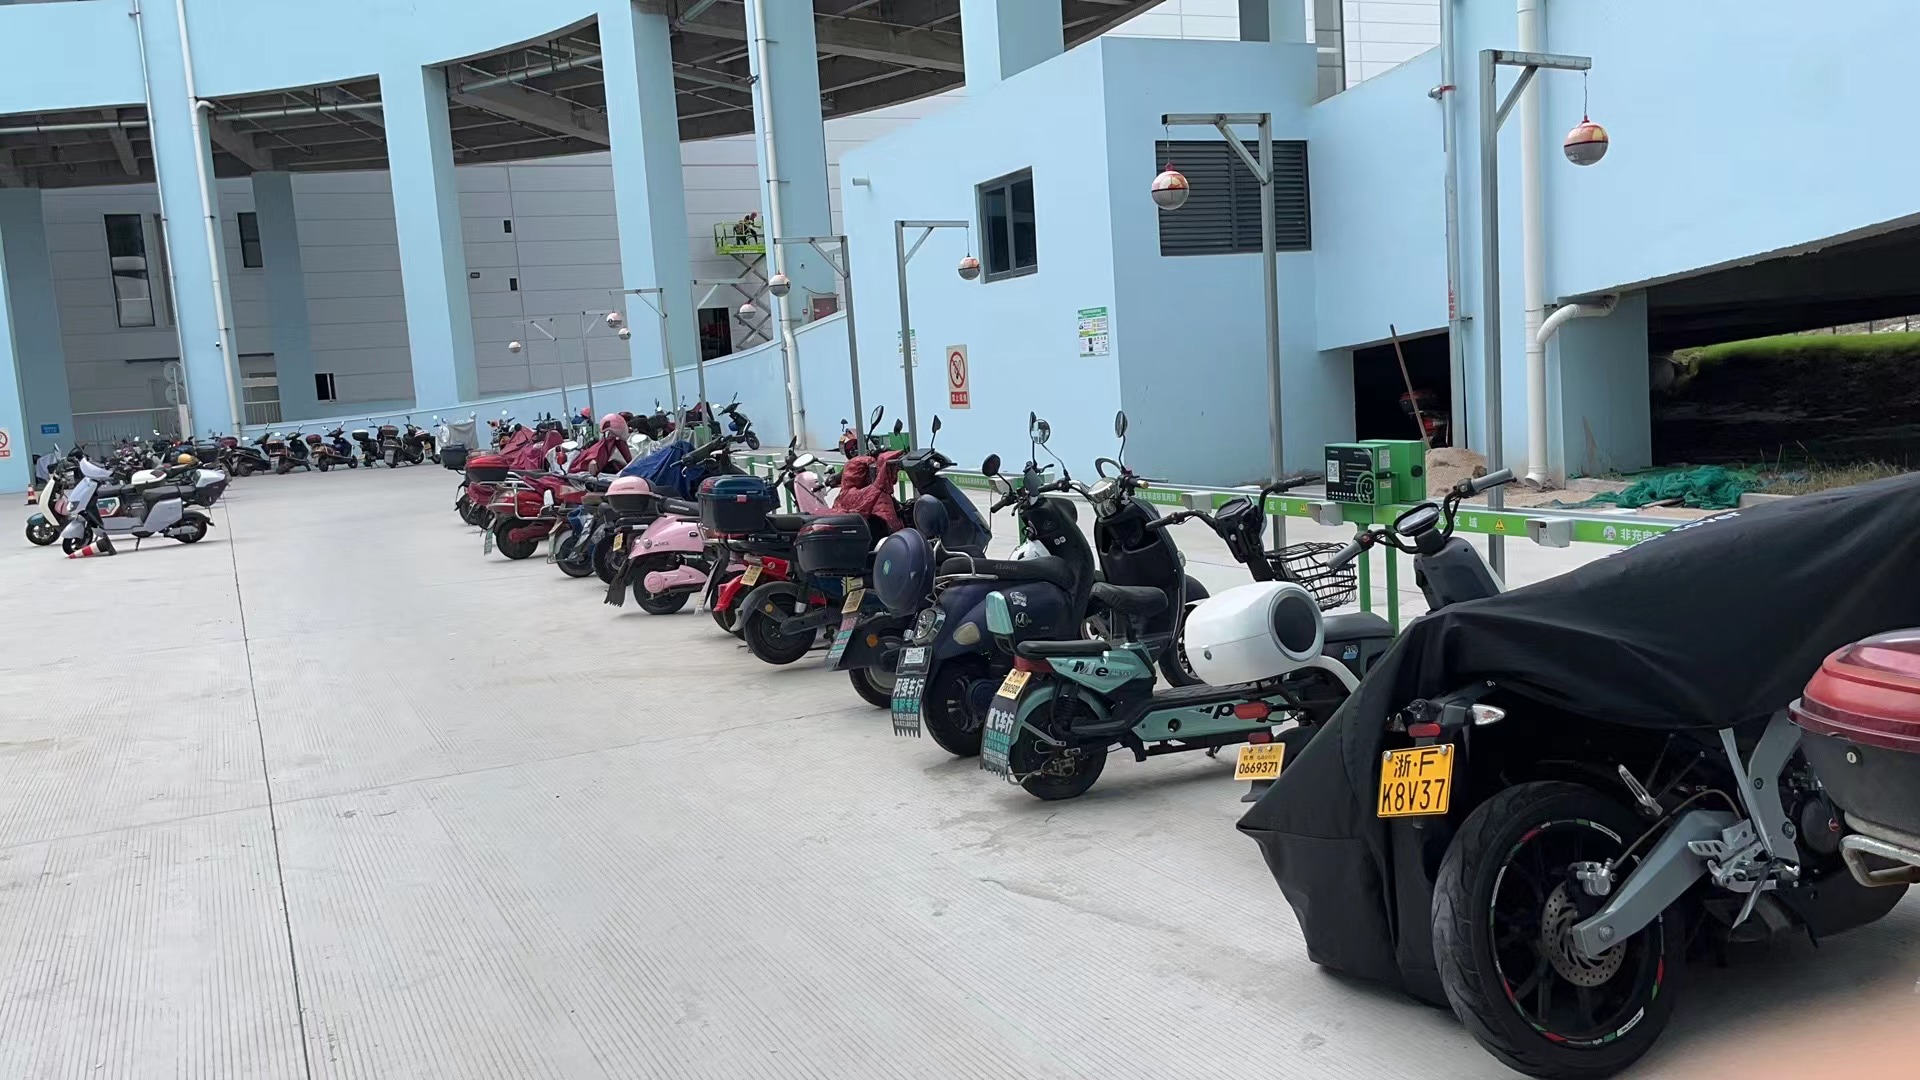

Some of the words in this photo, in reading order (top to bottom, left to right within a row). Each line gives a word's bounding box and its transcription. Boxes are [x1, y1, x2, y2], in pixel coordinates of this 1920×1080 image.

[893, 678, 925, 698] 阿强车行
[1238, 761, 1278, 774] 0669371
[1381, 778, 1446, 813] K8V37
